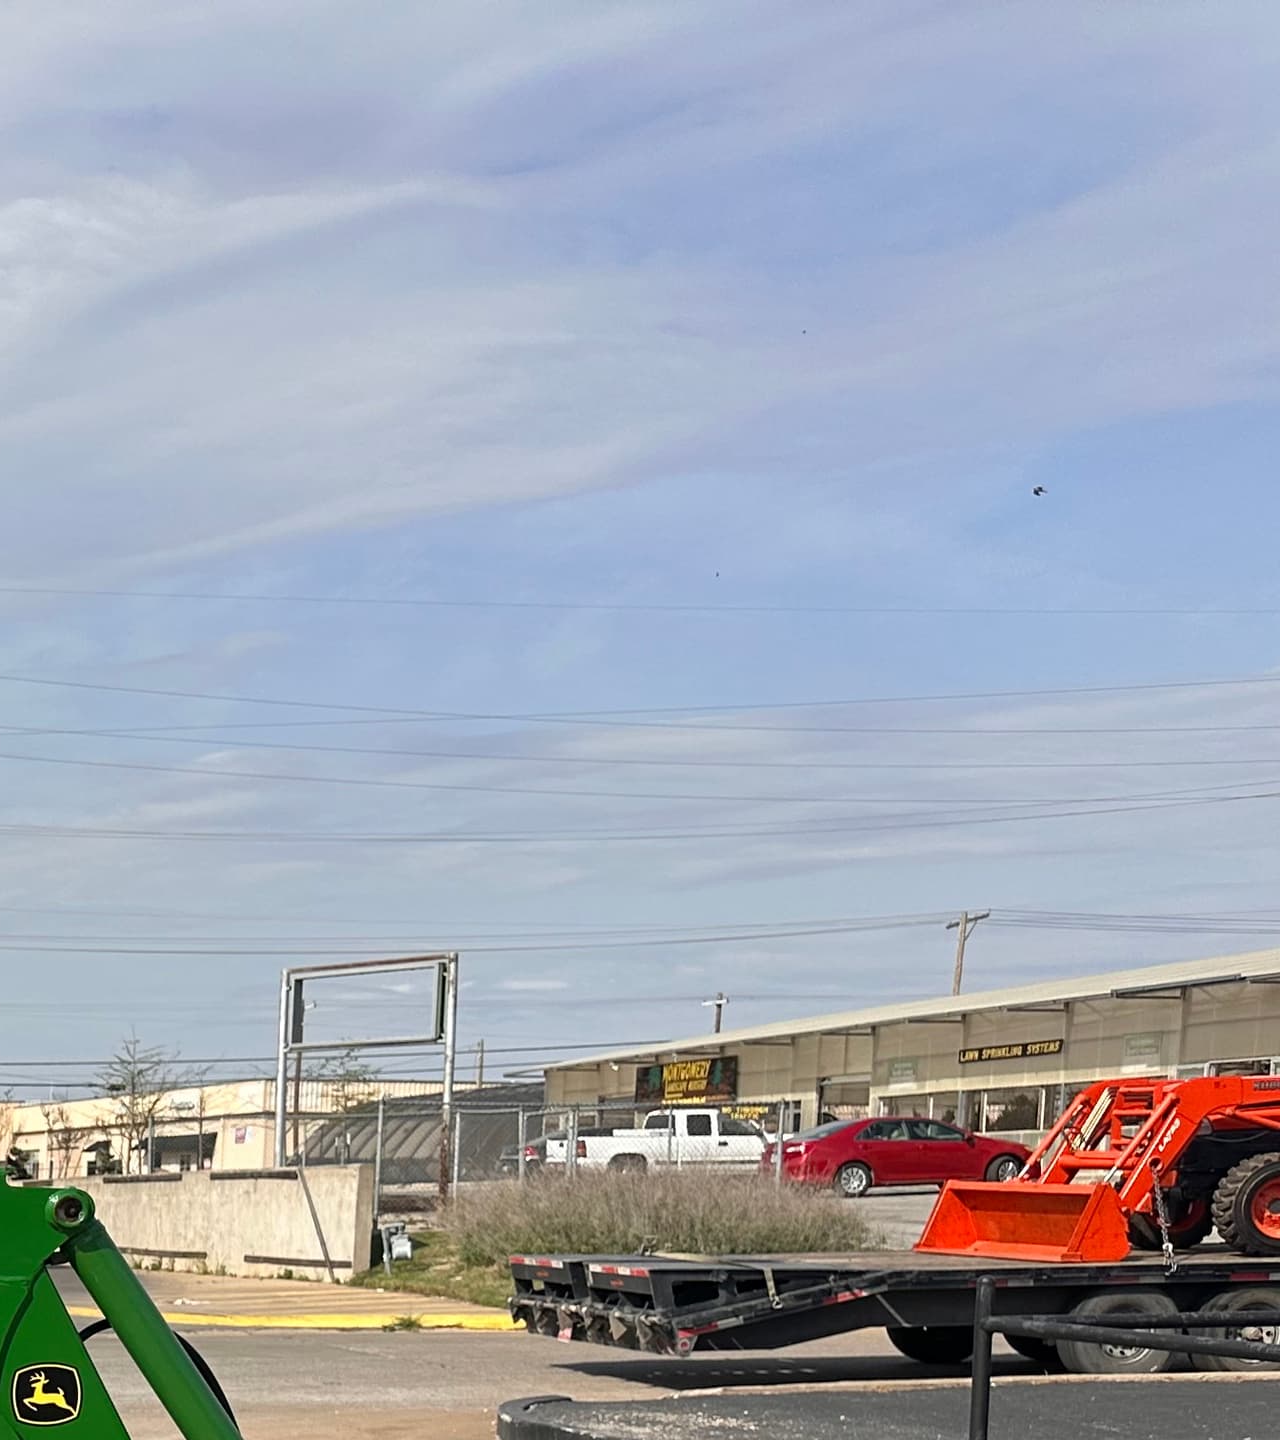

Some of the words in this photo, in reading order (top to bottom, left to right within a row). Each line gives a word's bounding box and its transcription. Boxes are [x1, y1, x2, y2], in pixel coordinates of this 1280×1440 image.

[960, 1050, 979, 1062] LAWN
[981, 1046, 1023, 1060] SPRINKLING
[1026, 1040, 1060, 1055] SYSTEMS
